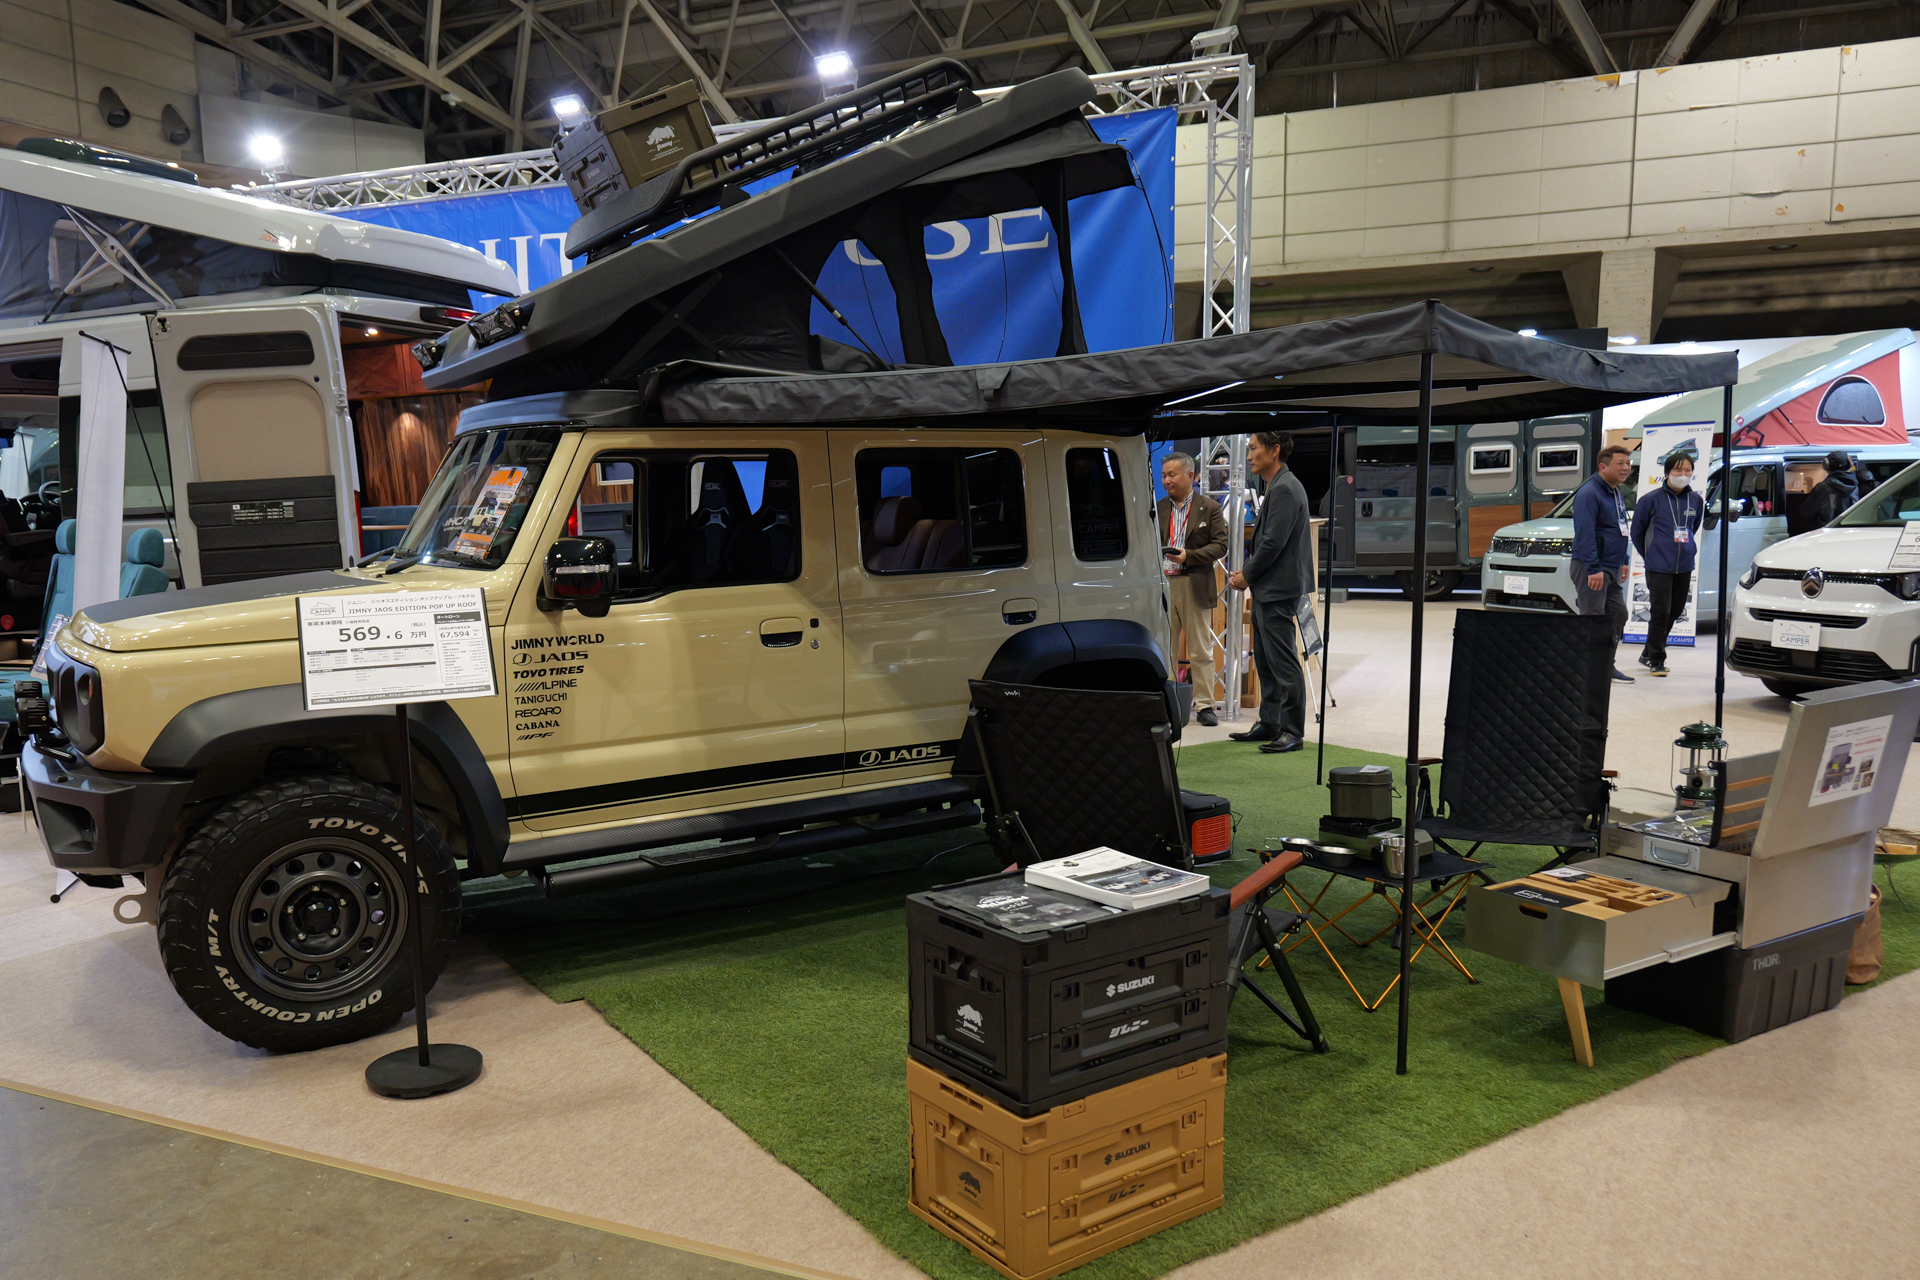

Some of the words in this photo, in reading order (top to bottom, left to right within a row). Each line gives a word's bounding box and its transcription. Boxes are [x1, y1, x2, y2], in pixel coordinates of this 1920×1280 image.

[348, 607, 372, 615] JIMNY
[395, 604, 427, 612] EDITION
[410, 631, 427, 639] 万円
[440, 631, 470, 639] 67,594
[1780, 636, 1810, 645] CAMPER
[534, 651, 589, 663] JAOS
[513, 668, 547, 679] TOYO
[549, 665, 585, 676] TIRES
[524, 679, 578, 692] ALPINE
[514, 693, 568, 705] TANIGUCHI
[515, 706, 562, 718] RECARO
[516, 720, 560, 731] CABANA
[881, 745, 941, 763] JAOS
[308, 817, 380, 836] TOYO
[206, 907, 222, 957] M/T
[1117, 975, 1155, 993] SUZUKI
[214, 965, 311, 1023] COUNTRY
[316, 989, 383, 1022] OPEN
[1114, 1142, 1151, 1161] SUZUKI
